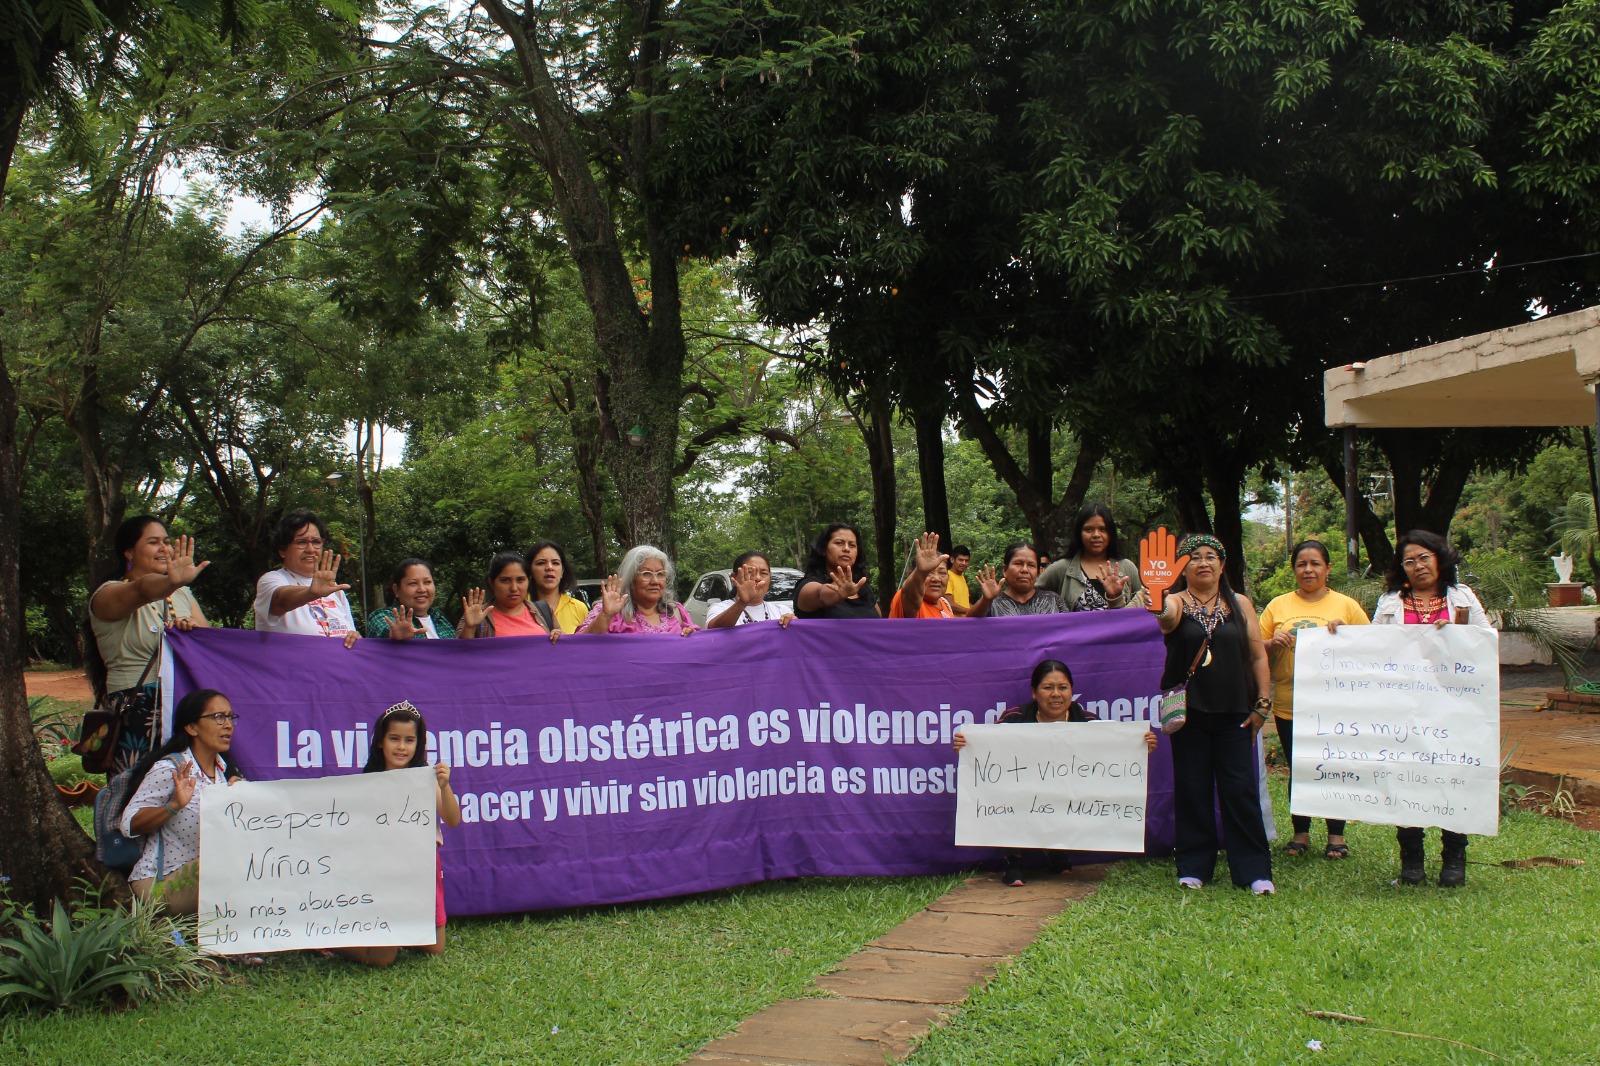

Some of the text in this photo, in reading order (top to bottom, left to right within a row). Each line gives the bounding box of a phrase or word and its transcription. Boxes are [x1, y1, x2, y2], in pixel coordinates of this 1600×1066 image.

[1150, 560, 1167, 570] YO
[1339, 656, 1398, 672] mundo
[1350, 680, 1370, 692] paz
[276, 720, 323, 768] La
[539, 711, 740, 764] obstétrica
[747, 708, 791, 747] es
[1371, 720, 1449, 743] mujeres
[974, 751, 1002, 788] No
[1372, 770, 1392, 785] por
[1450, 775, 1466, 790] que
[441, 788, 534, 824] acer
[540, 788, 559, 822] y
[564, 779, 633, 817] vivir
[638, 775, 688, 812] sin
[692, 760, 826, 807] violencia
[831, 766, 867, 795] es
[225, 798, 350, 839] Respeto
[375, 811, 390, 826] a
[1066, 799, 1144, 822] MUJERES
[246, 846, 332, 882] Niñas
[214, 891, 374, 921] No más abusos
[215, 923, 239, 945] No
[253, 920, 292, 940] más
